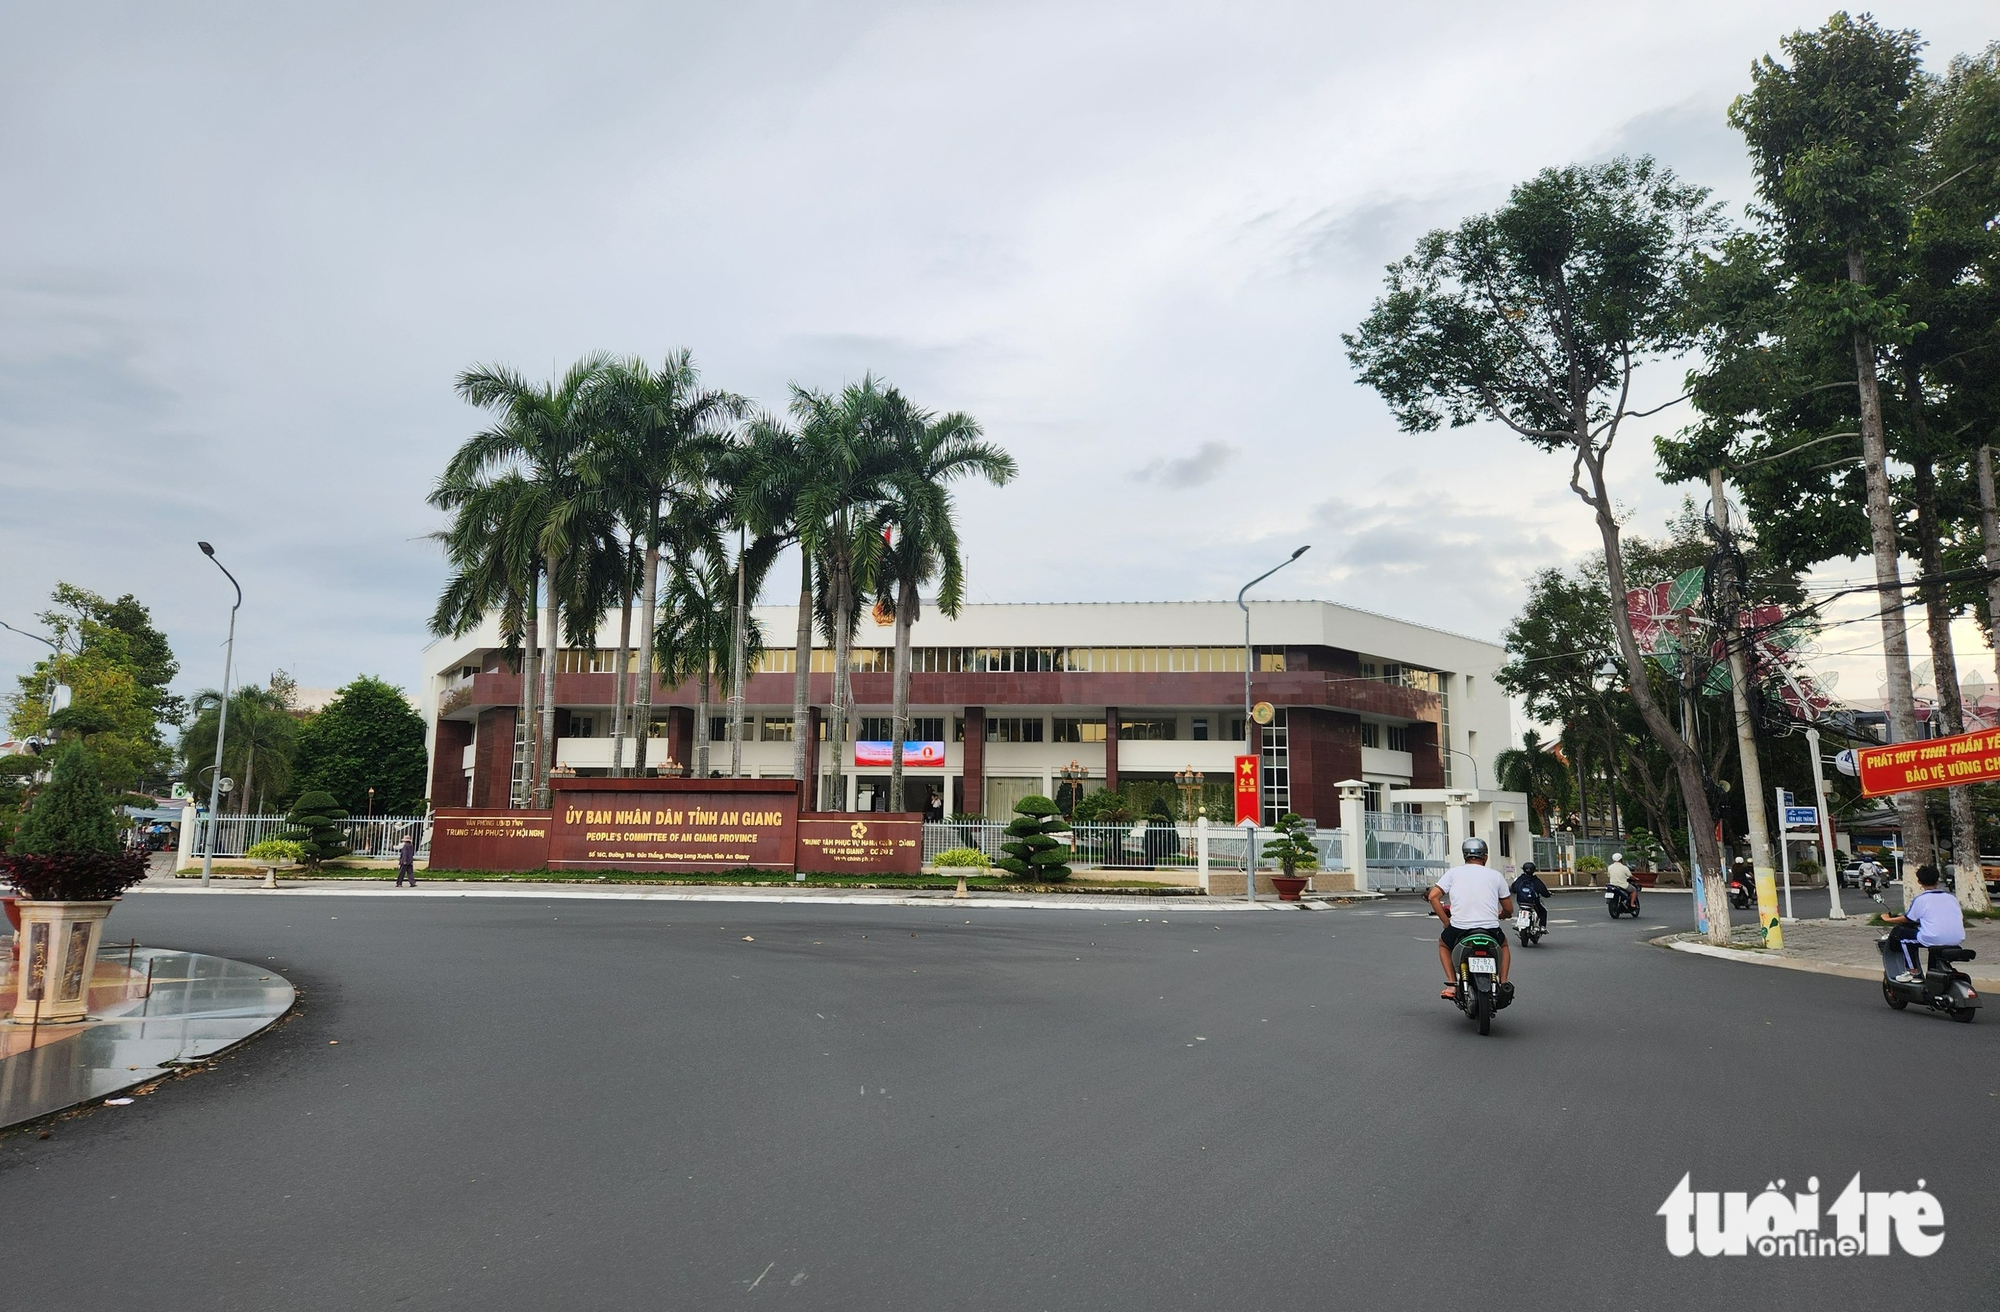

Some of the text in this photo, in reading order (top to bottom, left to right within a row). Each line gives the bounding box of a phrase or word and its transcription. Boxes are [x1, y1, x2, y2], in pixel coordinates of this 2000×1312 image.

[1867, 753, 1892, 769] PHÁT
[1895, 750, 1918, 764] HUY
[1920, 744, 1947, 760] TINH
[1950, 736, 1982, 755] THẦN
[1905, 765, 1928, 783] BẢO
[1930, 763, 1945, 780] VỆ
[1948, 760, 1981, 776] VỮNG
[566, 805, 782, 826] ỦY BAN NHÂN DÂN TỈNH AN GIANG
[516, 828, 528, 838] HỘI
[529, 830, 545, 838] NGHỊ
[586, 832, 757, 843] PEOPLE'S COMMITTEE OF AN GIANG PROVINCE
